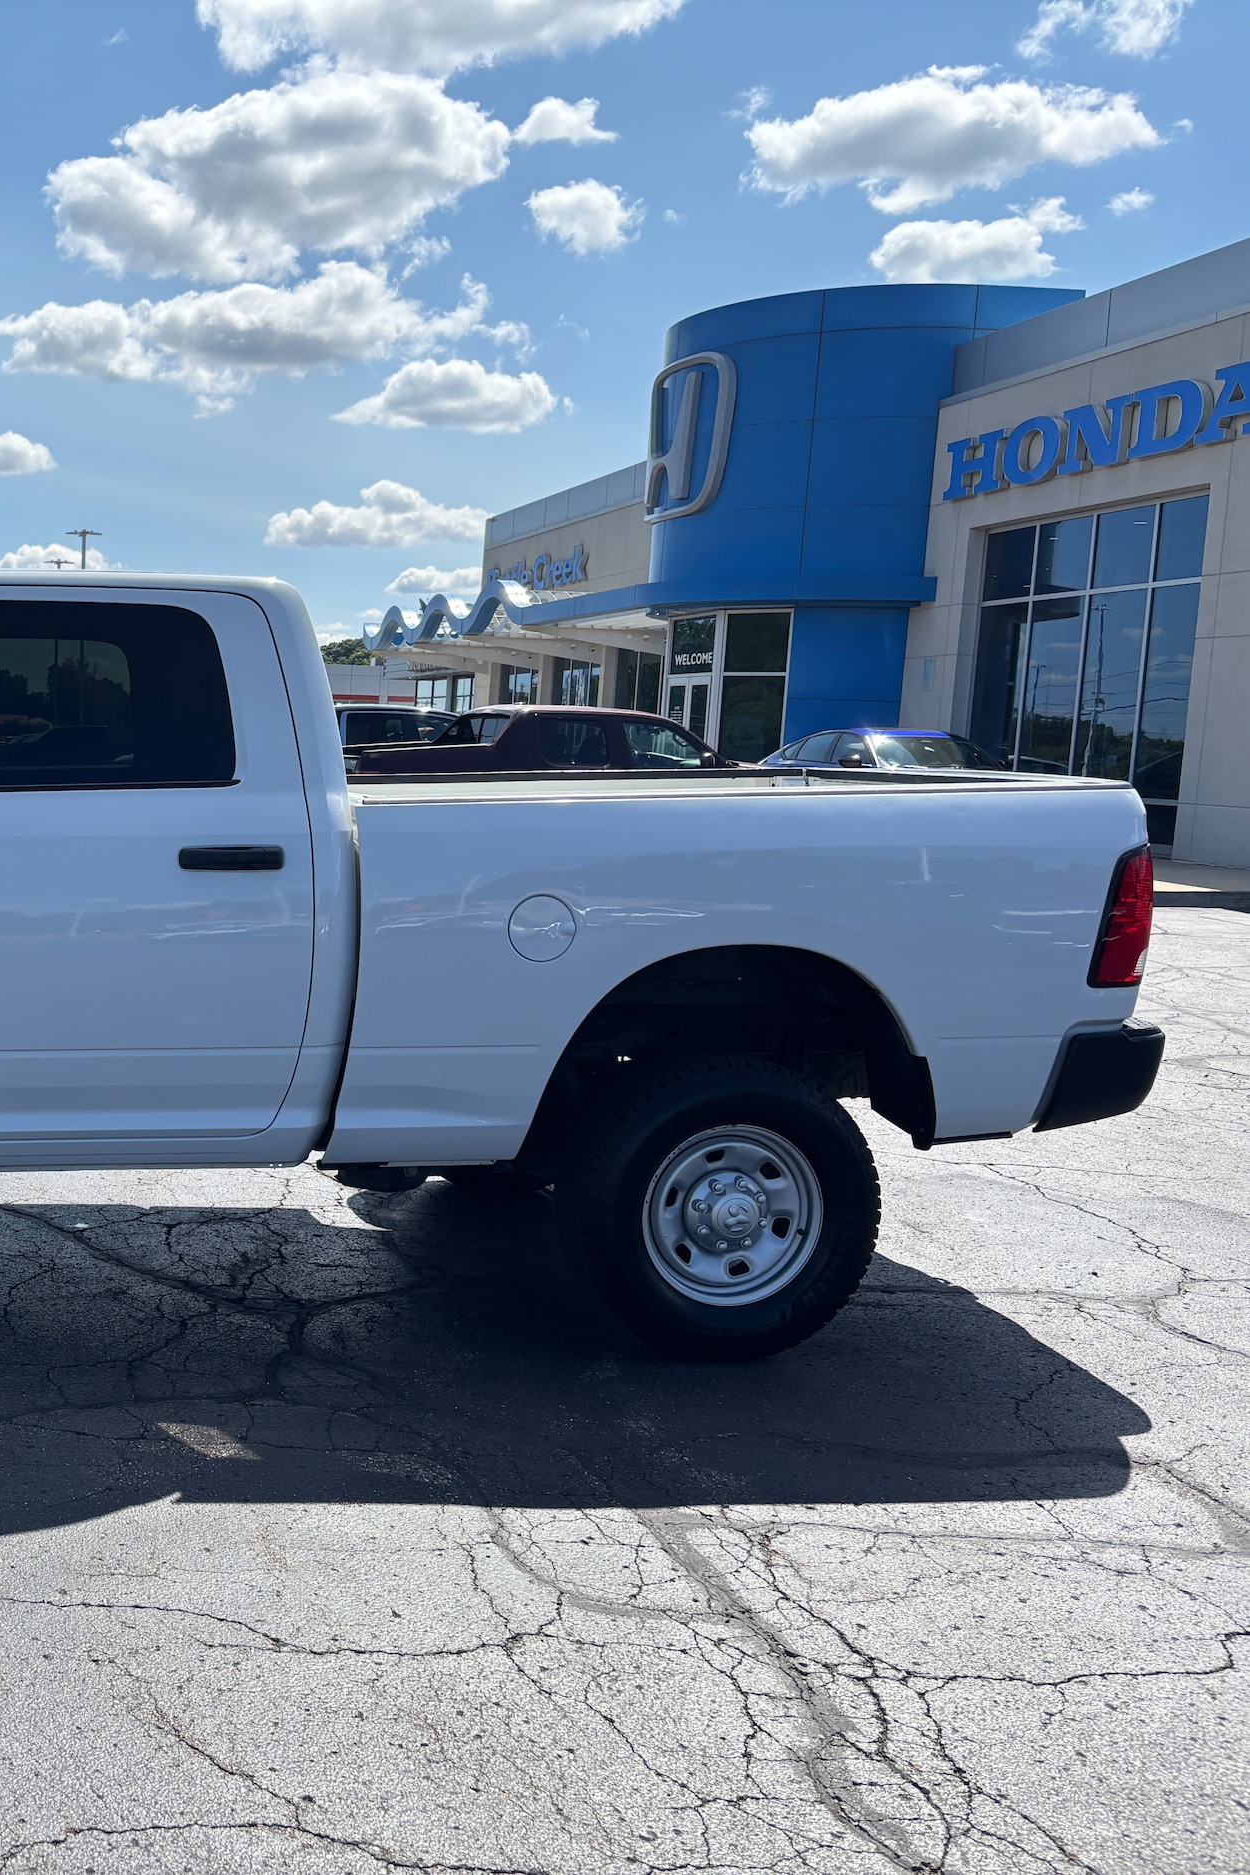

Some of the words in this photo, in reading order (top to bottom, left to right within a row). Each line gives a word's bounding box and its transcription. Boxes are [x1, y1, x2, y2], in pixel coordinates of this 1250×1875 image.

[942, 361, 1250, 501] HONDA
[533, 544, 588, 590] Creek
[674, 652, 713, 666] WELCOME
